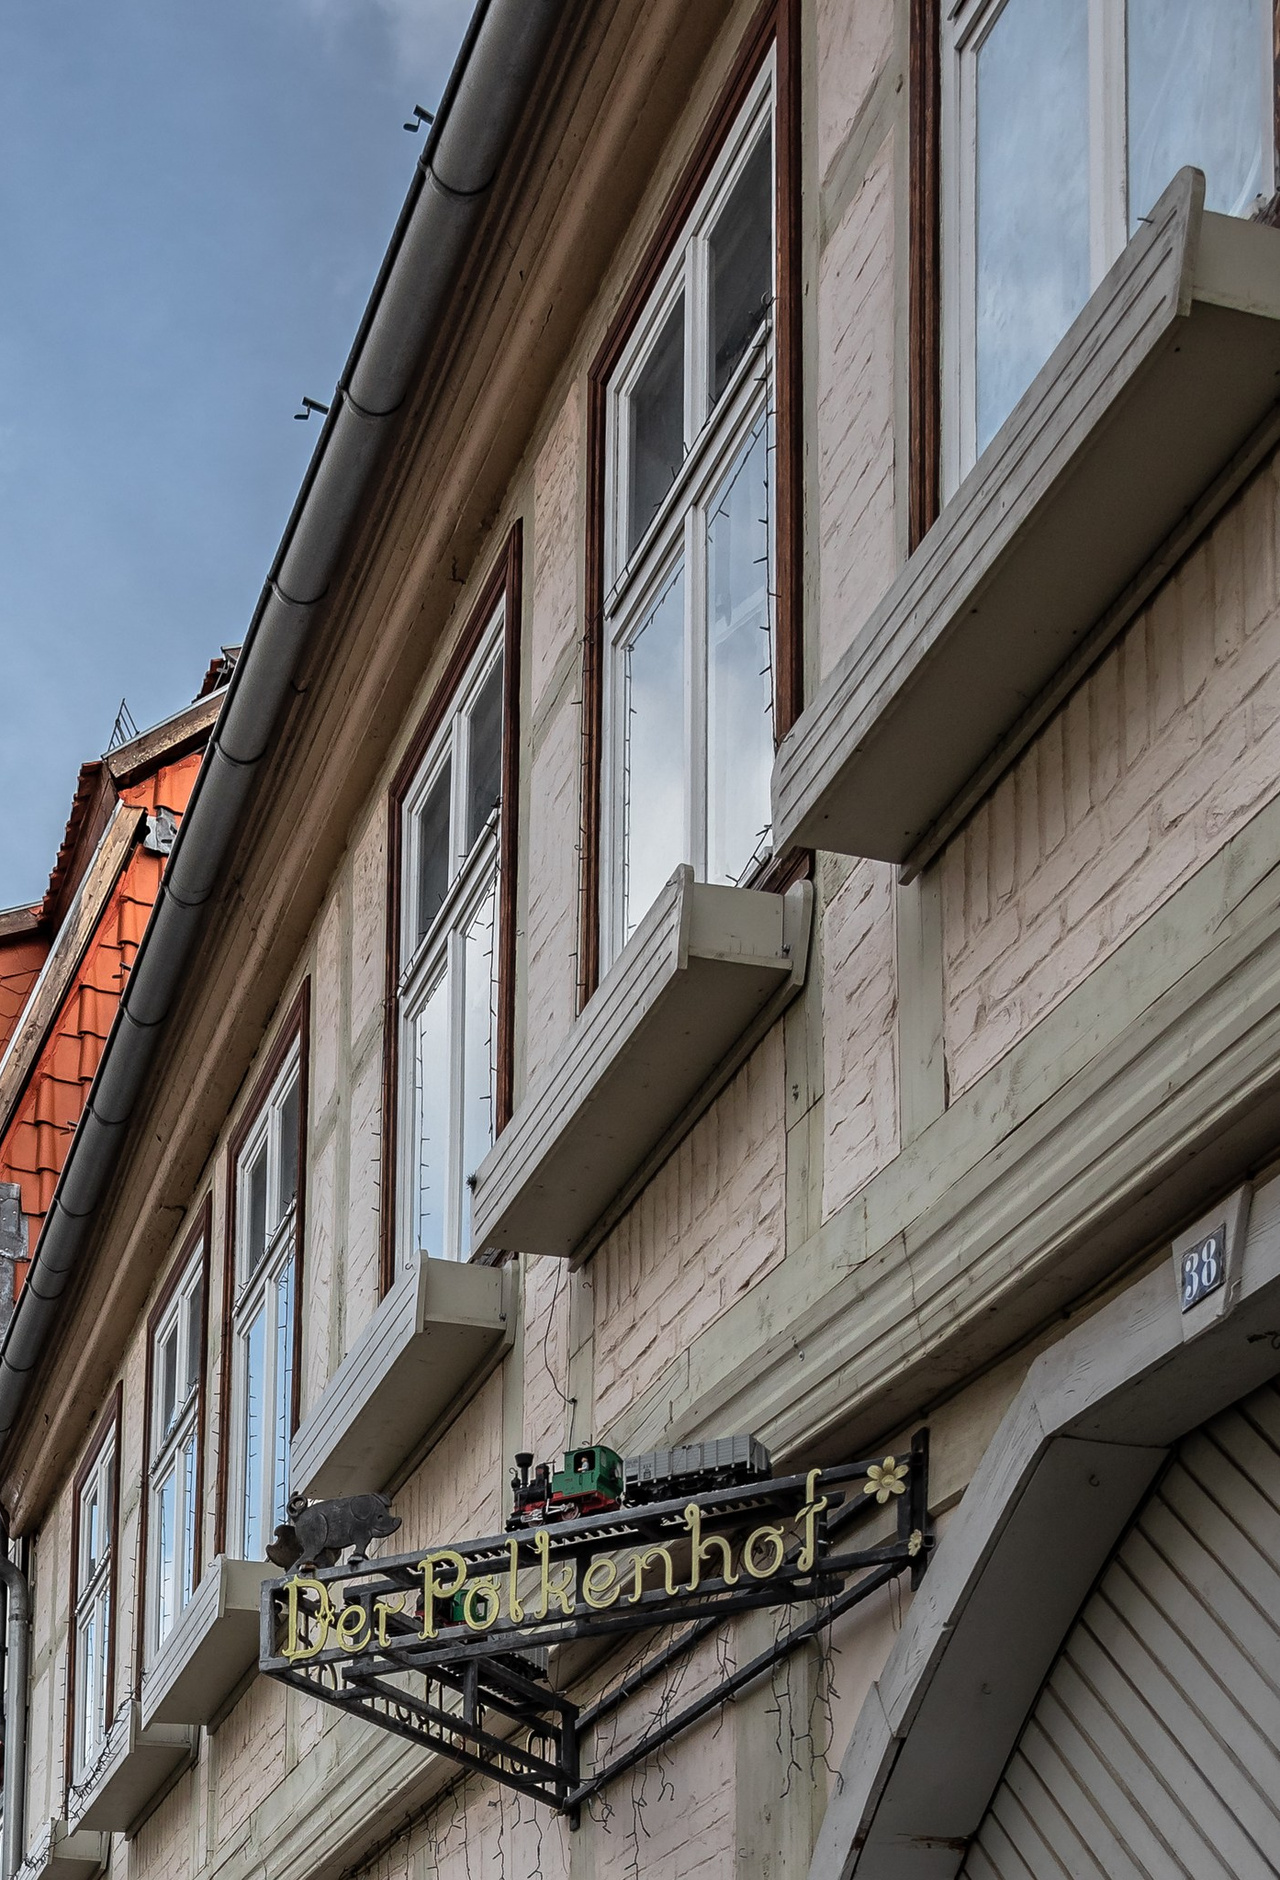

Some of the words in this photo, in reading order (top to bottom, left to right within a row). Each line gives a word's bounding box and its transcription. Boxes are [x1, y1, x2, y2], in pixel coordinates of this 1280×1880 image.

[1184, 1238, 1217, 1301] 38
[281, 1574, 406, 1665] Der
[417, 1468, 828, 1641] Pölkenhof
